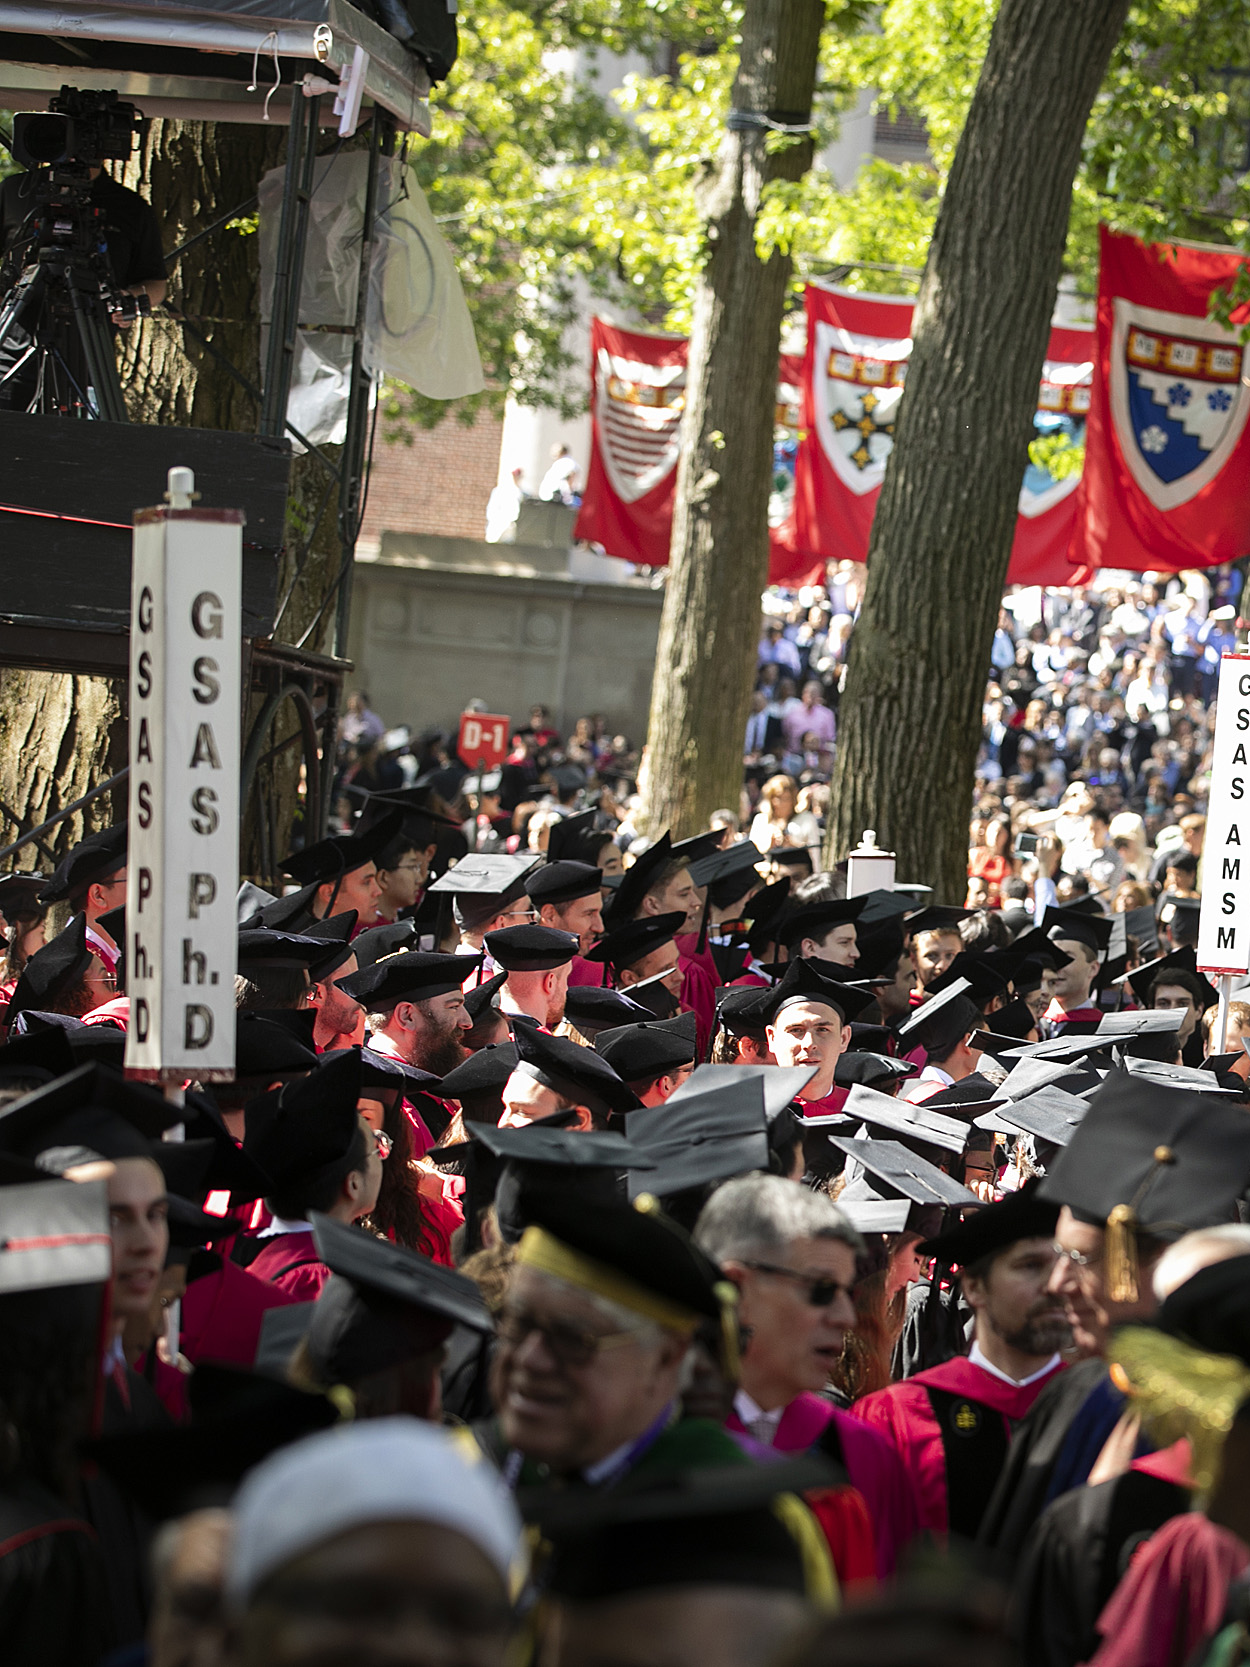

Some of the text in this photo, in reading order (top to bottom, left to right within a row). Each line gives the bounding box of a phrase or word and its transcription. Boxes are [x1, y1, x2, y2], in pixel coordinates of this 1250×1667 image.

[137, 584, 154, 830] GSAS
[189, 590, 224, 836] GSAS
[462, 720, 504, 753] D-1
[1216, 823, 1242, 950] AMSM
